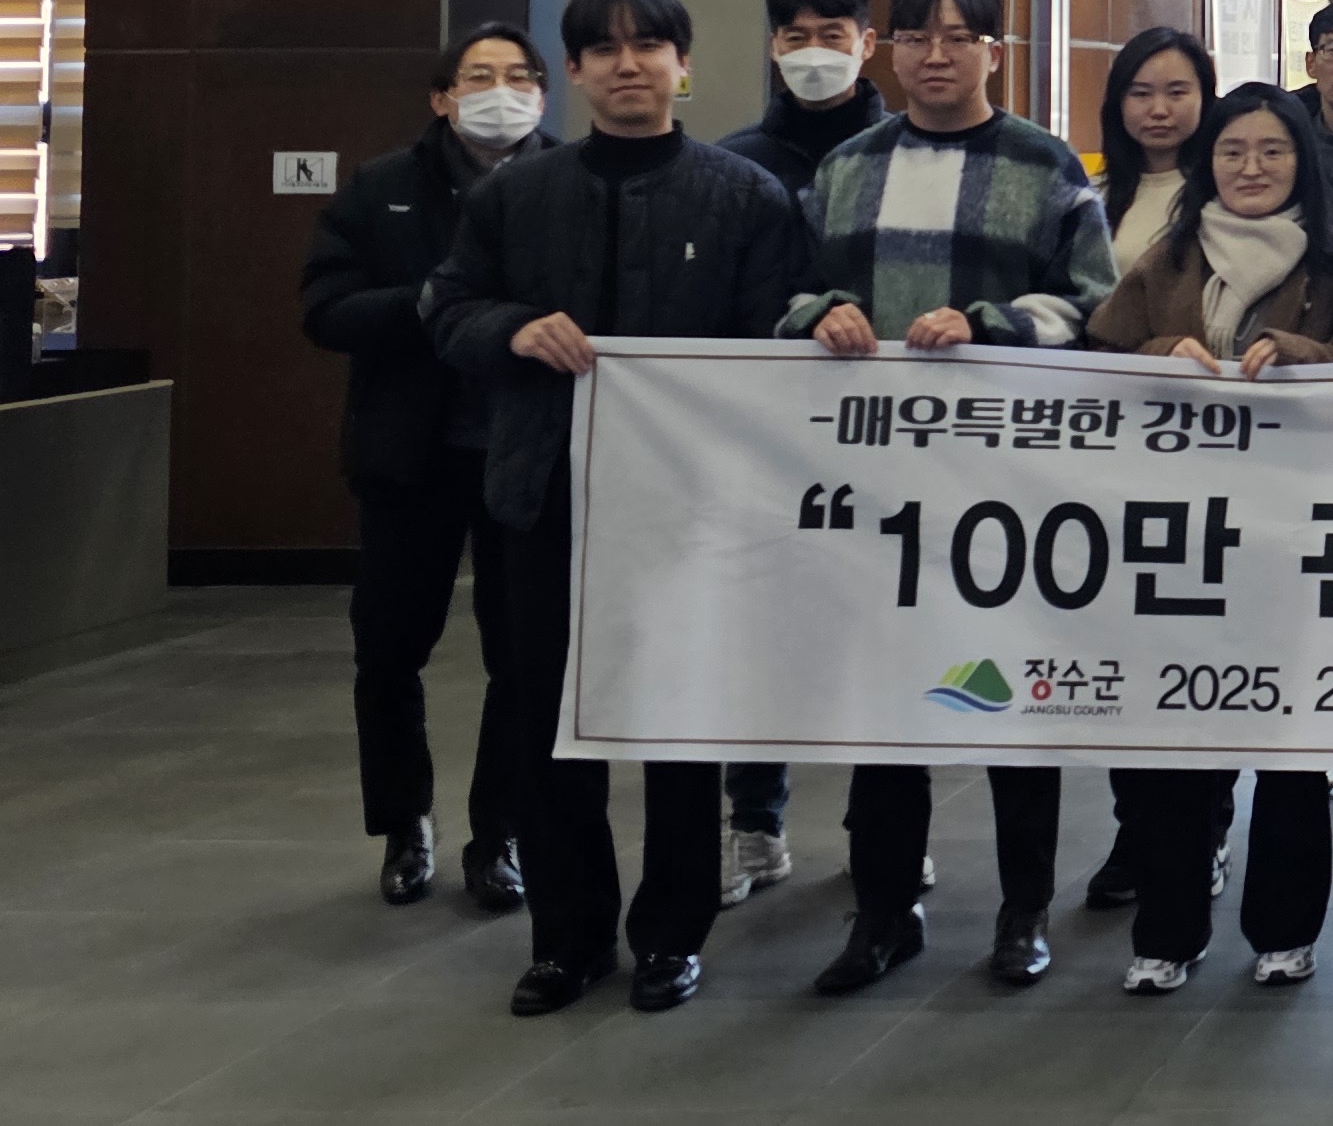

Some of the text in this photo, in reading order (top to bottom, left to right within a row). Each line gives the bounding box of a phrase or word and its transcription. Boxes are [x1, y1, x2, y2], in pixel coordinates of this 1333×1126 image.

[810, 396, 1282, 453] -매우특별한 강의-
[798, 482, 1241, 617] “100만
[1024, 659, 1125, 701] 장수군
[1157, 664, 1293, 715] 2025.
[1021, 704, 1123, 717] JANGSU COUNTY
